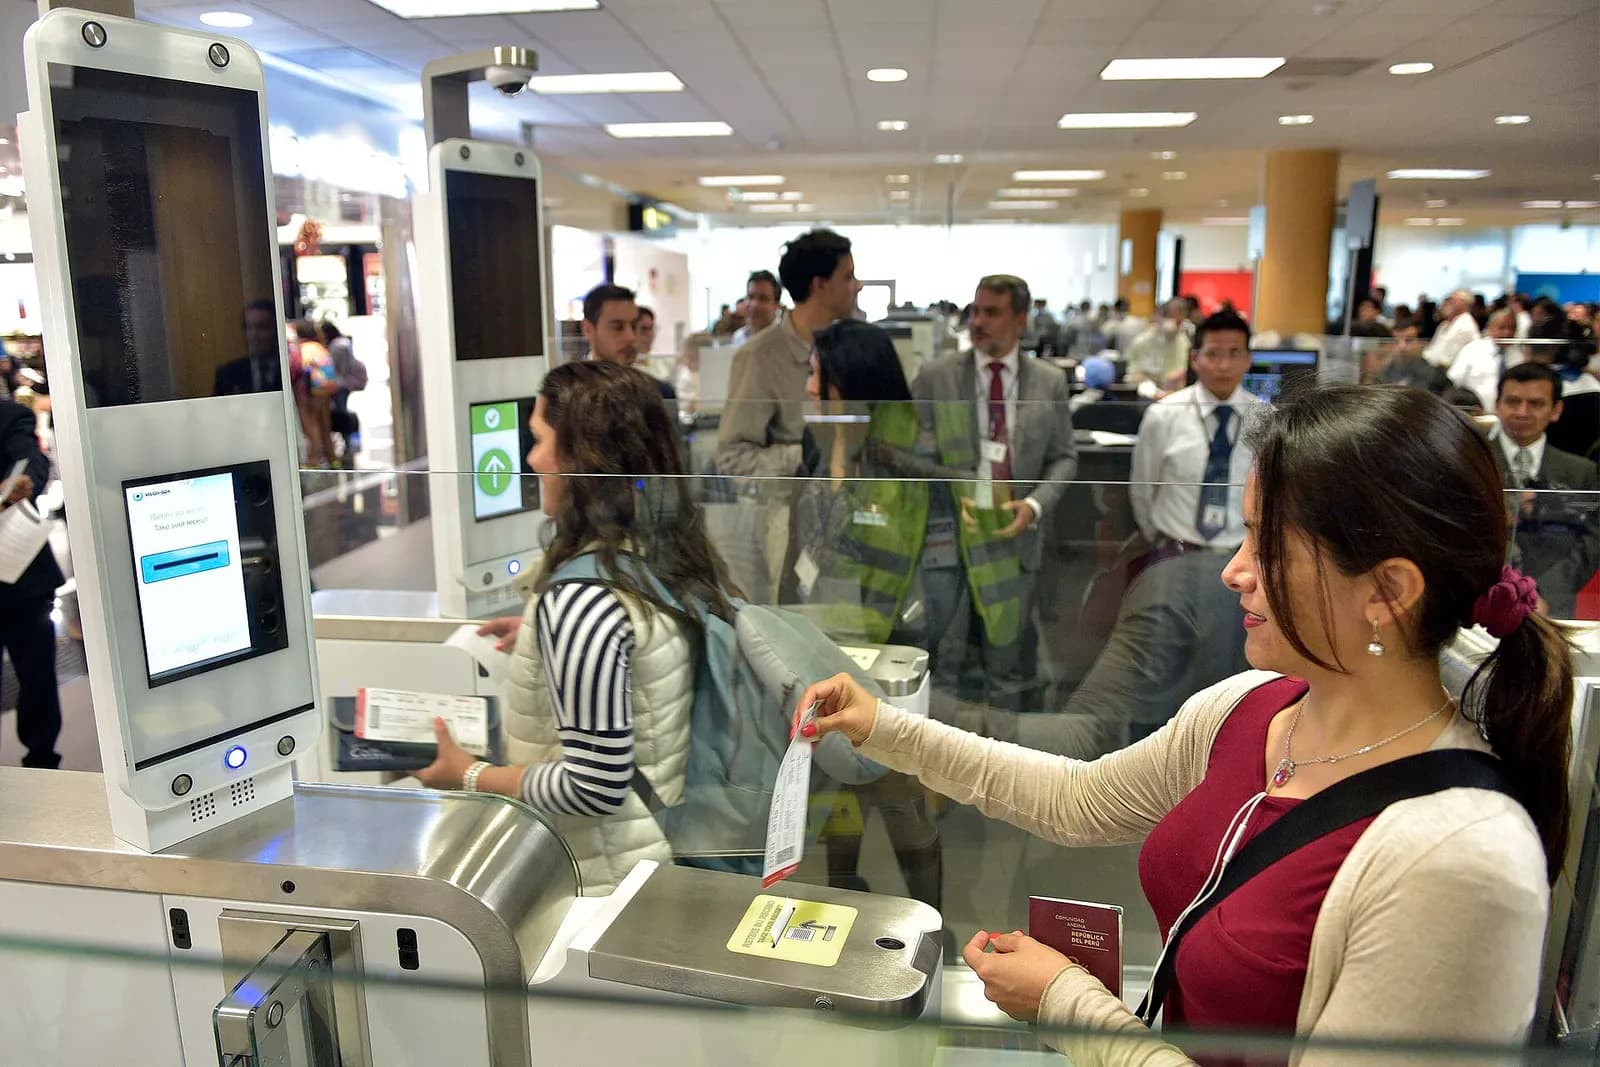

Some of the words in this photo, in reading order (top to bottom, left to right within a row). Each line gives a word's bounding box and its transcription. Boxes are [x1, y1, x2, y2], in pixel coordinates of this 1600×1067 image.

[1055, 915, 1085, 923] COMUNIDAD
[1071, 931, 1104, 941] REPÚBLICA
[1071, 937, 1083, 945] DEL
[1084, 938, 1100, 947] PERÚ
